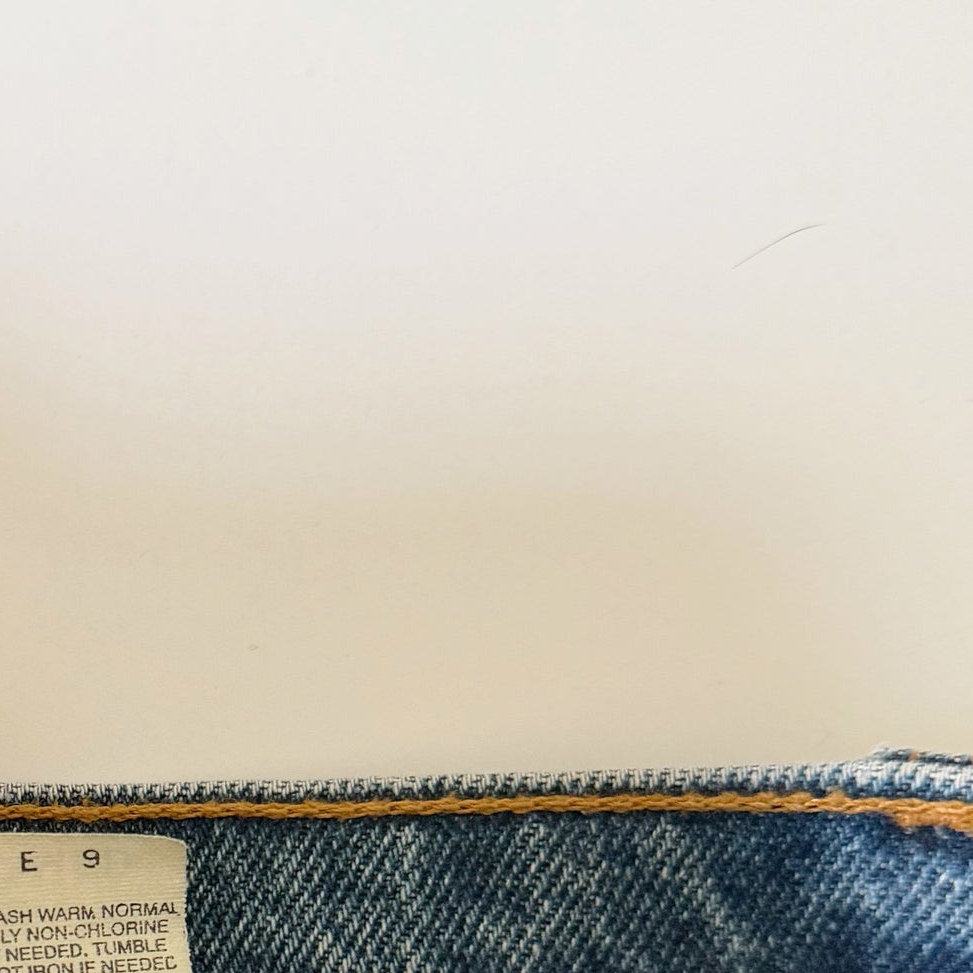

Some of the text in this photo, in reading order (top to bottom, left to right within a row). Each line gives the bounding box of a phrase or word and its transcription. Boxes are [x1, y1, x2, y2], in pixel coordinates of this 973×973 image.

[21, 851, 38, 872] E
[82, 849, 100, 868] 9
[27, 920, 169, 941] NON-CHLORINE
[95, 939, 167, 955] TUMBLE
